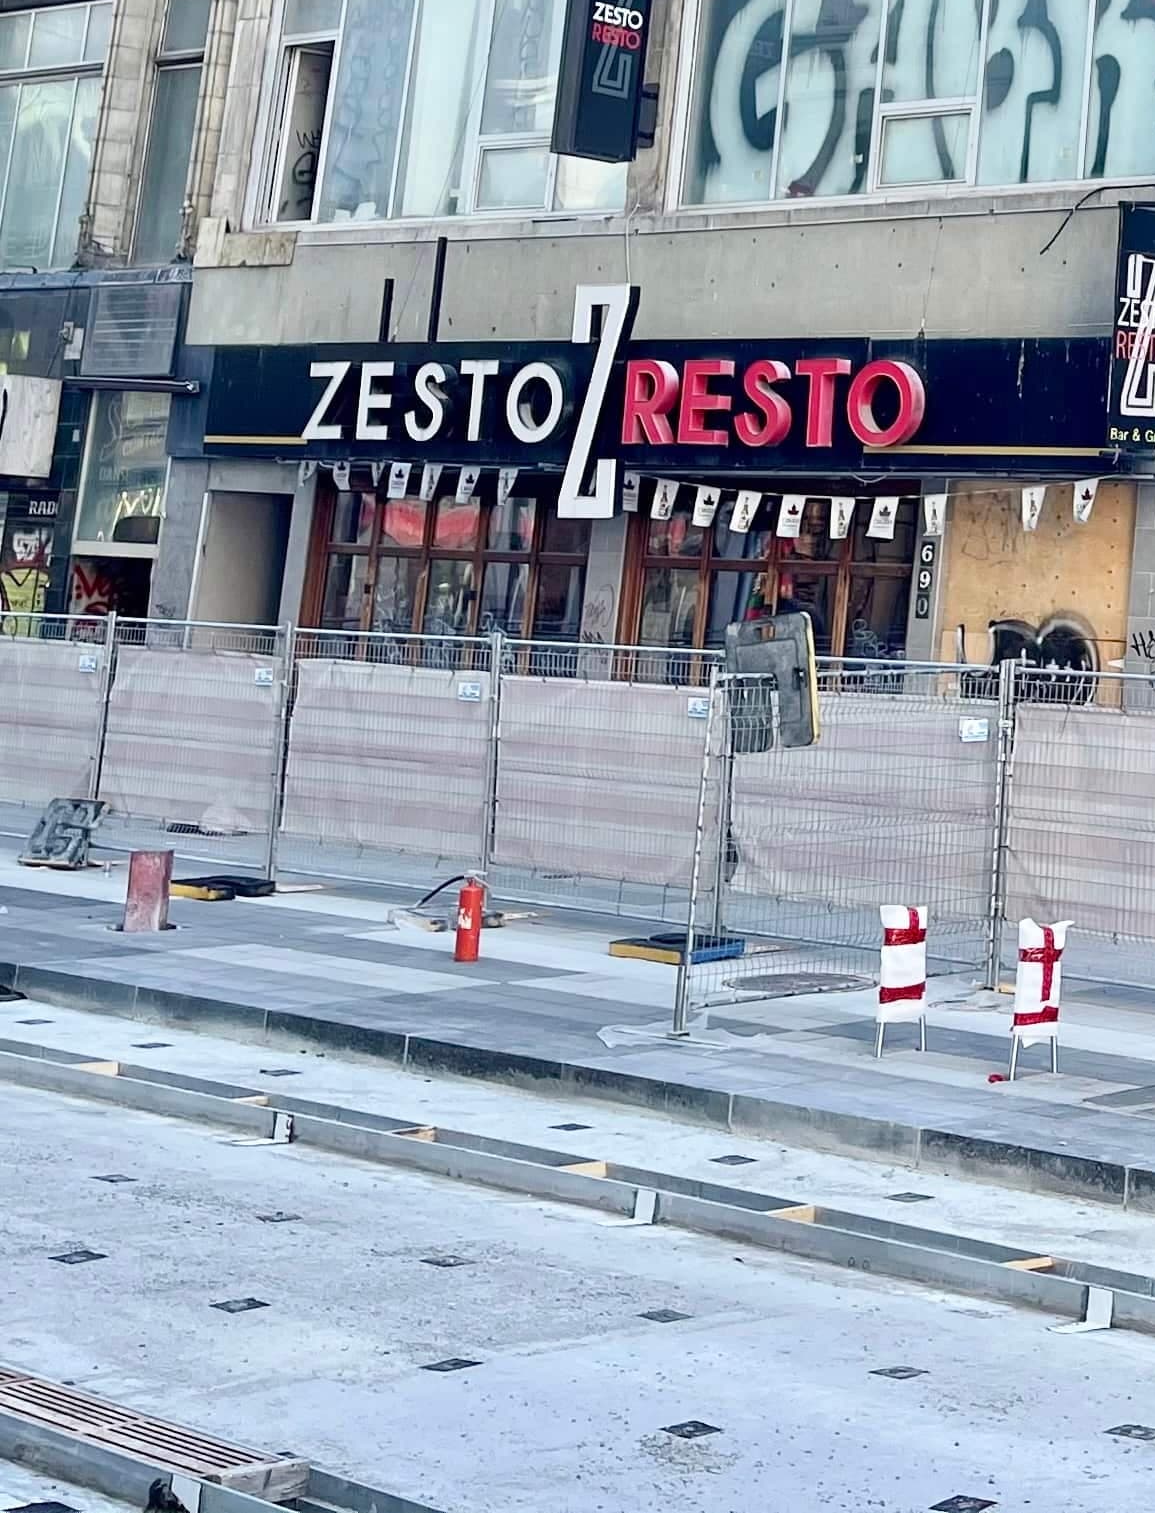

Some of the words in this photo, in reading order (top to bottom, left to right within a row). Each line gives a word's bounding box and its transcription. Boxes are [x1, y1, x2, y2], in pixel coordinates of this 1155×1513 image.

[592, 1, 643, 30] ZESTO
[591, 23, 641, 50] RESTO
[301, 360, 563, 443] ZESTO
[621, 358, 925, 447] RESTO
[1110, 427, 1129, 442] Bar
[1132, 428, 1141, 443] &
